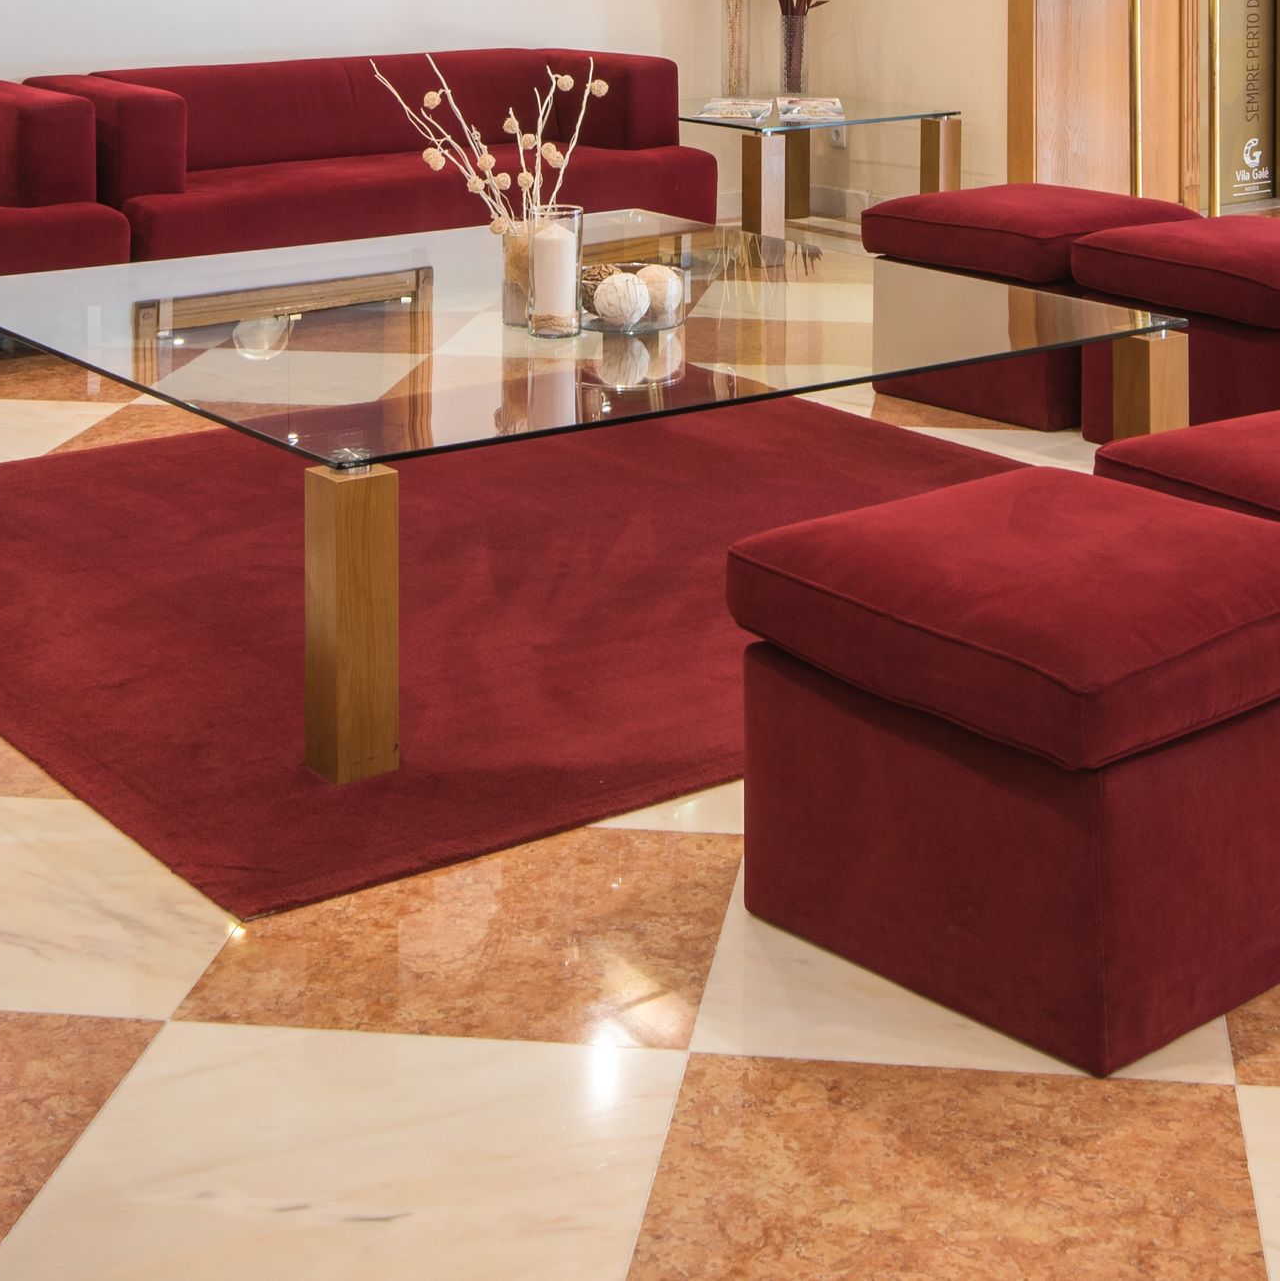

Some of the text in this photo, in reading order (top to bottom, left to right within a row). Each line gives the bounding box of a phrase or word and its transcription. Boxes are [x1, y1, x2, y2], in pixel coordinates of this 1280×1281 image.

[1246, 13, 1260, 58] PERTO
[1246, 63, 1260, 122] SEMPRE
[1235, 166, 1270, 182] Vila Galé
